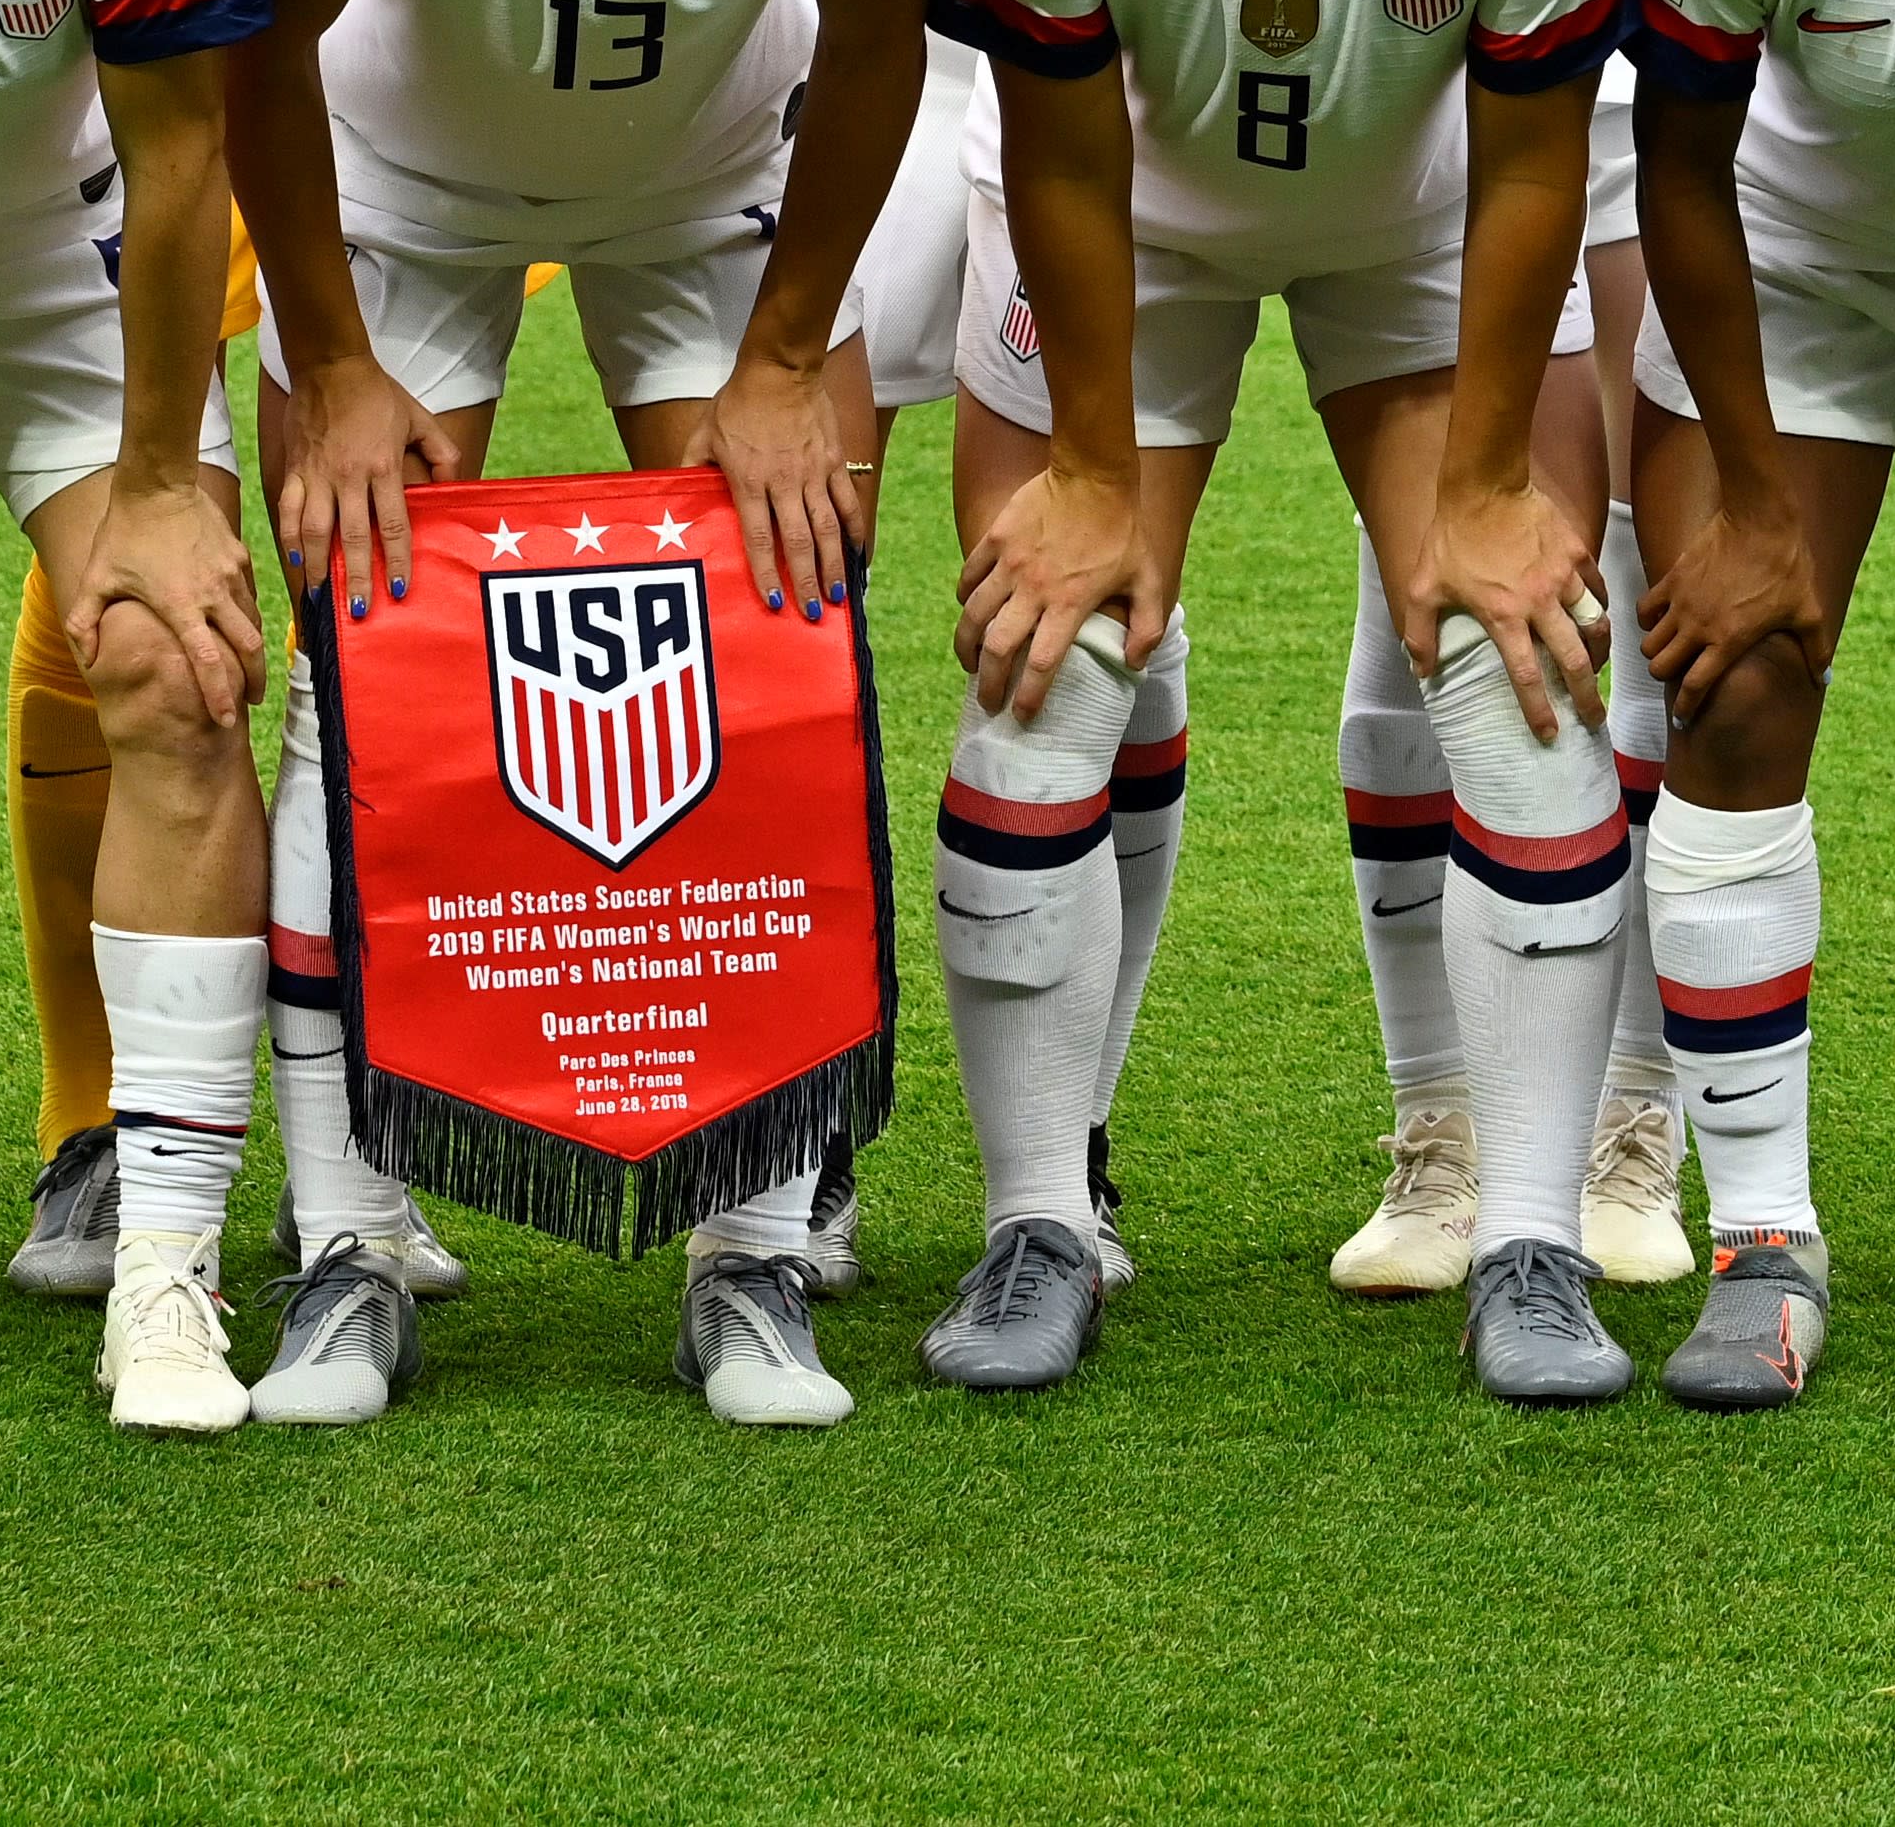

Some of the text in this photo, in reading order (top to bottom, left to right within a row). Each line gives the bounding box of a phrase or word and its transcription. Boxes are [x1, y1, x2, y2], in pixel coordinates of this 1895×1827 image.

[1260, 27, 1296, 38] FIFA
[1236, 71, 1311, 171] 8
[503, 582, 690, 694] USA
[427, 875, 806, 922] United States Soccer Federation
[427, 910, 812, 958] 2019 FIFA Women's World Cup
[465, 950, 777, 991] Women's National Team
[541, 1002, 708, 1041] Quarterfinal
[559, 1047, 696, 1072] Parc Des Princes
[576, 1071, 683, 1094] Paris, France
[575, 1093, 688, 1117] June 28, 2019
